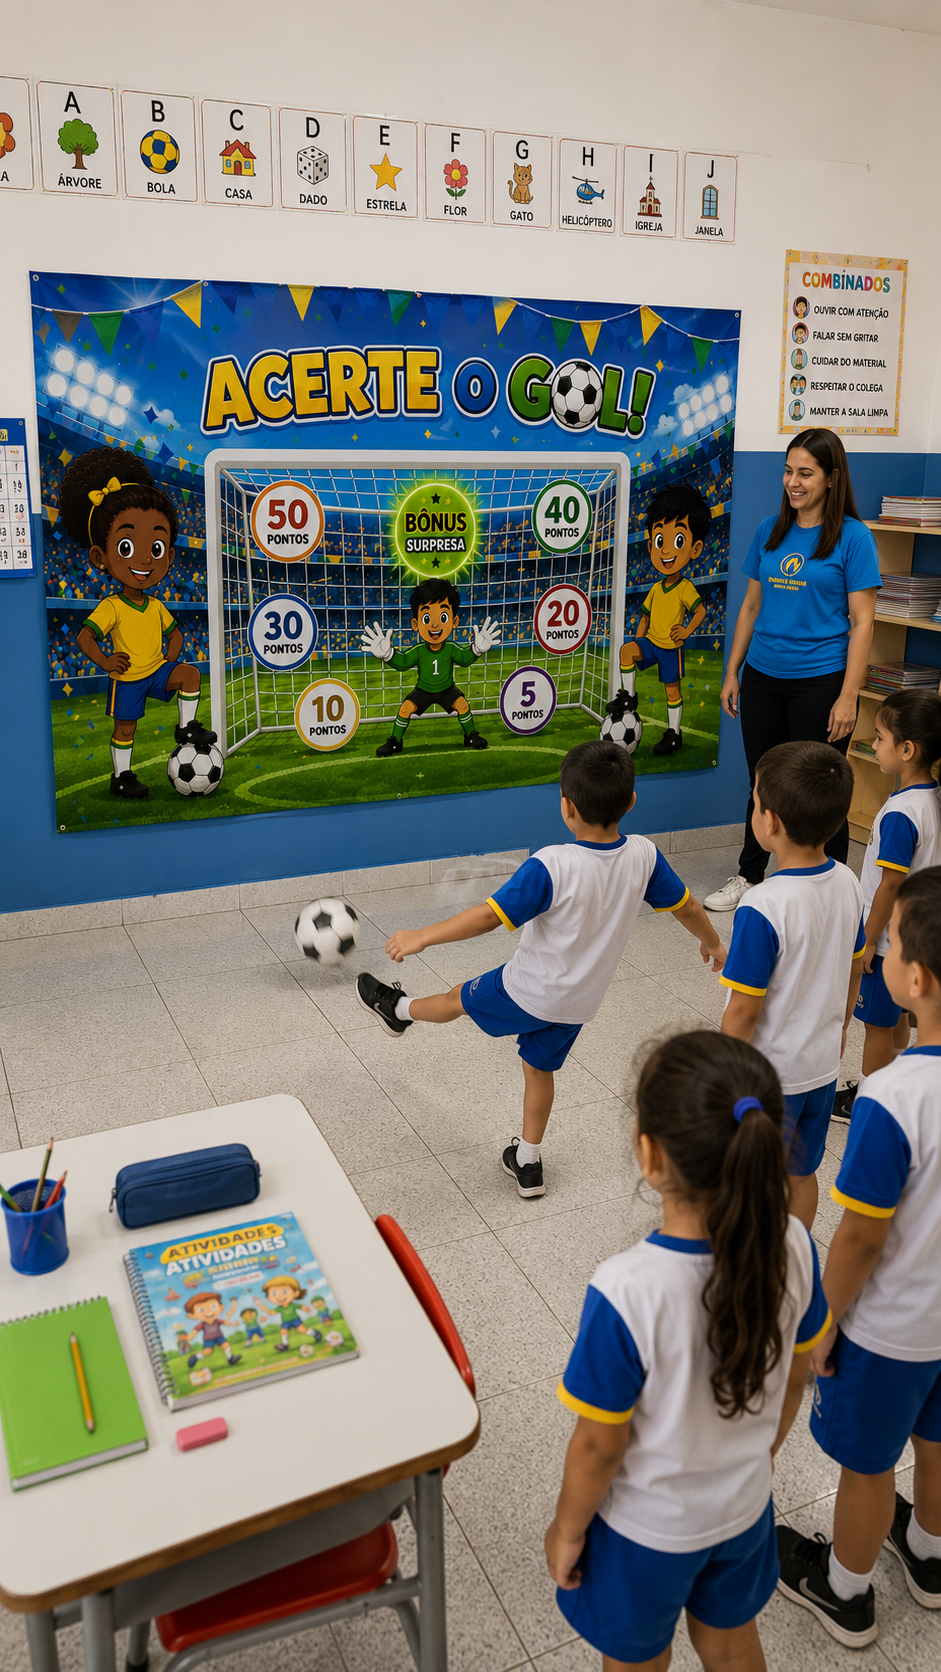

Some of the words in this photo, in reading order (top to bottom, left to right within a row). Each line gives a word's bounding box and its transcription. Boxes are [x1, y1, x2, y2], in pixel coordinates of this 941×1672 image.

[64, 91, 81, 113] A
[152, 100, 165, 122] B
[230, 109, 243, 131] C
[306, 117, 320, 138] D
[380, 125, 390, 146] E
[451, 133, 460, 152] F
[516, 140, 528, 159] G
[583, 147, 593, 166] H
[649, 154, 654, 172] I
[705, 160, 714, 178] J
[58, 173, 101, 189] ÁRVORE
[148, 182, 175, 194] BOLA
[225, 188, 252, 199] CASA
[300, 194, 327, 205] DADO
[367, 199, 406, 211] ESTRELA
[444, 205, 467, 216] FLOR
[510, 211, 533, 221] GATO
[561, 216, 612, 229] HELICÓPTERO
[636, 221, 662, 231] IGREJA
[695, 226, 723, 236] JANELA
[814, 306, 836, 315] OUVIR
[838, 307, 854, 316] COM
[856, 307, 889, 320] ATENÇÃO
[813, 331, 835, 340] FALAR
[837, 333, 851, 342] SEM
[854, 334, 878, 343] GRITAR
[812, 357, 838, 366] CUIDAR
[841, 358, 851, 367] DO
[853, 359, 886, 368] MATERIAL
[204, 348, 440, 430] ACERTE
[454, 360, 497, 415] O
[811, 382, 847, 391] RESPEITAR
[849, 383, 854, 392] O
[856, 384, 883, 393] COLEGA
[810, 408, 839, 416] MANTER
[841, 408, 846, 416] A
[849, 408, 865, 417] SALA
[868, 409, 888, 417] LIMPA
[267, 499, 308, 530] 50
[545, 495, 579, 524] 40
[406, 508, 467, 533] BÔNUS
[267, 533, 309, 545] PONTOS
[545, 527, 579, 539] PONTOS
[406, 538, 465, 553] SURPRESA
[547, 600, 579, 627] 20
[264, 611, 303, 640] 30
[546, 629, 579, 640] PONTOS
[263, 643, 303, 655] PONTOS
[432, 660, 439, 676] 1
[522, 681, 535, 707] 5
[312, 695, 345, 722] 10
[511, 709, 544, 720] PONTOS
[309, 725, 347, 737] PONTOS
[168, 1226, 277, 1258] ATIVIDADES
[166, 1236, 287, 1276] ATIVIDADES
